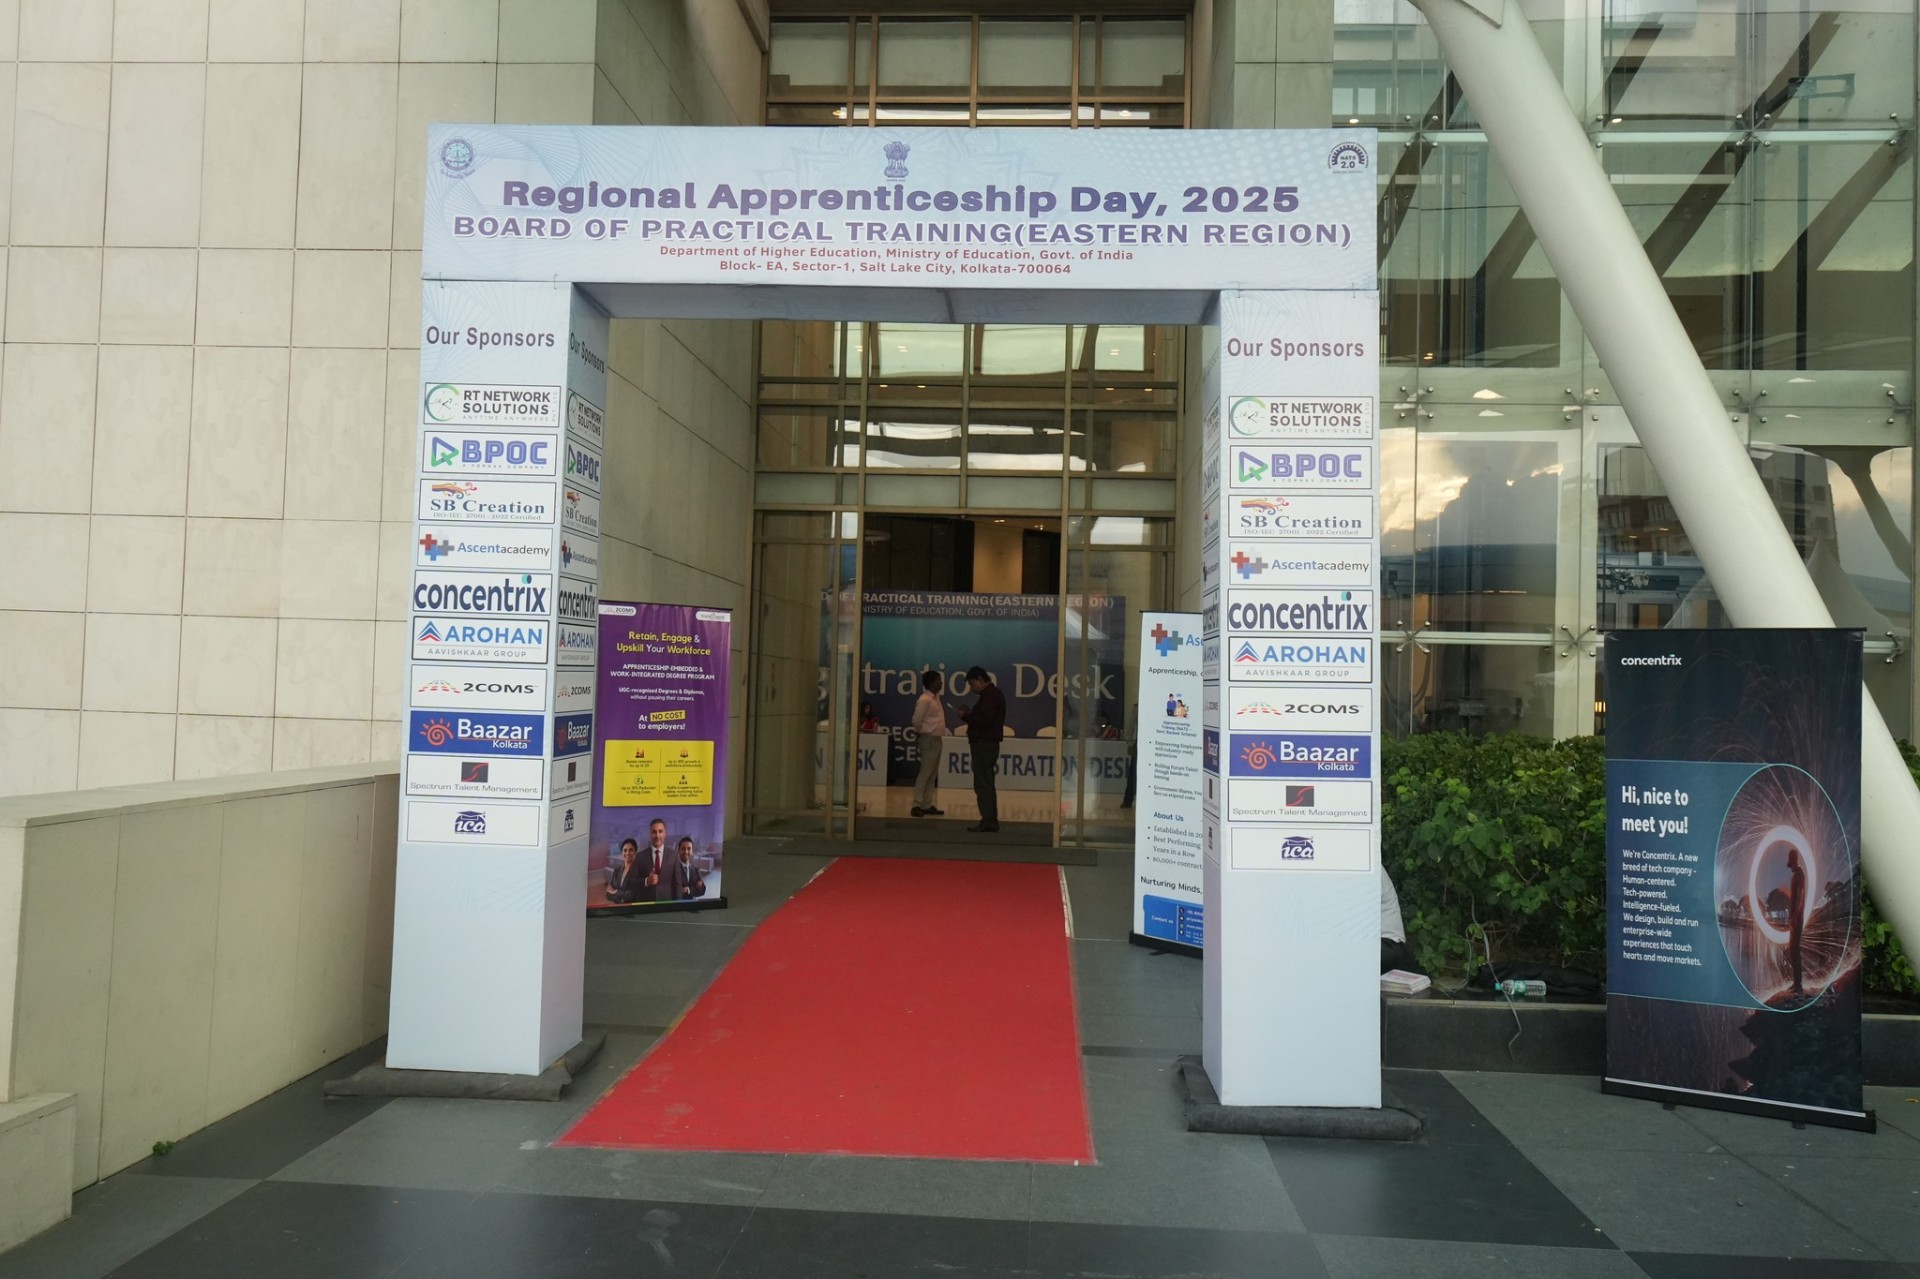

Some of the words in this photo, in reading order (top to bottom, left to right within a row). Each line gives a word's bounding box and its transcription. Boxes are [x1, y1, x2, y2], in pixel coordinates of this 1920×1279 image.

[1341, 161, 1356, 169] 2.0
[503, 181, 697, 214] Regional
[707, 183, 1057, 219] Apprenticeship
[1071, 186, 1168, 219] Day,
[1182, 186, 1299, 213] 2025
[454, 216, 572, 238] BOARD
[585, 218, 629, 239] OF
[641, 219, 833, 242] PRACTICAL
[845, 221, 1188, 247] TRAINING(EASTERN
[1203, 223, 1352, 248] REGION)
[660, 246, 739, 258] Department
[743, 247, 758, 257] of
[760, 247, 806, 260] Higher
[810, 248, 881, 260] Education,
[886, 248, 941, 261] Ministry
[945, 249, 960, 259] of
[963, 249, 1035, 261] Education,
[1040, 250, 1074, 260] Govt.
[1080, 250, 1095, 260] of
[1097, 250, 1134, 260] India
[720, 260, 762, 271] Block-
[767, 260, 788, 273] EA,
[793, 261, 855, 274] Sector-1,
[861, 261, 887, 272] Salt
[891, 262, 921, 273] Lake
[926, 263, 956, 275] City,
[961, 263, 1072, 274] Kolkata-700064
[426, 325, 461, 345] Our
[467, 326, 556, 351] Sponsors
[570, 332, 581, 355] Our
[581, 340, 605, 374] Sponsors
[1227, 337, 1263, 358] Our
[1270, 337, 1365, 361] Sponsors
[463, 390, 481, 402] RT
[483, 391, 552, 404] NETWORK
[462, 402, 549, 416] SOLUTIONS
[1270, 402, 1289, 414] RT
[1291, 402, 1364, 415] NETWORK
[462, 414, 500, 422] ANYTIME
[503, 416, 549, 424] ANYWHERE
[1269, 415, 1362, 428] SOLUTIONS
[461, 438, 549, 465] BPOC
[576, 450, 600, 483] BPOC
[1271, 453, 1363, 479] BPOC
[430, 498, 456, 512] SB
[462, 499, 545, 514] Creation
[574, 509, 598, 528] Creation
[1240, 514, 1268, 529] SB
[1274, 514, 1363, 529] Creation
[457, 541, 551, 557] Ascentacademy
[1271, 559, 1370, 573] Ascentacademy
[414, 574, 547, 613] concentrix
[853, 592, 925, 605] RACTICAL
[926, 594, 1055, 608] TRAINING(EASTERN
[559, 583, 596, 619] concentrix
[615, 607, 635, 615] 2COMS
[896, 605, 908, 614] OF
[910, 606, 965, 617] EDUCATION,
[968, 607, 993, 617] GOVT.
[995, 608, 1008, 617] OF
[1011, 608, 1040, 618] INDIA)
[1228, 591, 1368, 630] concentrix
[445, 625, 543, 645] AROHAN
[566, 631, 594, 649] AROHAN
[629, 631, 660, 643] Retain,
[661, 632, 693, 644] Engage
[694, 634, 701, 643] &
[427, 648, 490, 657] AAVISHKAAR
[493, 650, 528, 659] GROUP
[616, 643, 645, 654] Upskill
[646, 644, 665, 653] Your
[666, 645, 711, 657] Workforce
[1262, 644, 1366, 663] AROHAN
[1620, 653, 1683, 666] concentrix
[610, 670, 666, 679] WORK-INTEGRATED
[666, 672, 687, 680] DEGREE
[687, 673, 715, 681] PROGRAM
[1148, 666, 1200, 679] Apprenticeship,
[1245, 669, 1311, 677] AAVISHKAAR
[1315, 670, 1350, 678] GROUP
[463, 682, 535, 694] 2COMS
[570, 685, 592, 696] 2COMS
[658, 688, 678, 697] Degrees
[648, 695, 666, 703] pausing
[1284, 703, 1360, 714] 2COMS
[638, 714, 648, 722] At
[652, 713, 664, 721] NO
[664, 711, 684, 720] COST
[457, 717, 533, 741] Baazar
[567, 721, 590, 740] Baazar
[638, 722, 647, 730] to
[647, 722, 686, 733] employers!
[492, 740, 529, 750] Kolkata
[1280, 740, 1360, 762] Baazar
[948, 752, 1079, 778] RESTRATION
[1316, 761, 1355, 771] Kolkata
[409, 781, 452, 792] Spectrum
[455, 783, 480, 792] Talent
[482, 785, 539, 795] Management
[1621, 785, 1641, 806] Hi,
[1643, 786, 1672, 805] nice
[1674, 788, 1689, 806] to
[1153, 811, 1174, 822] About
[1175, 814, 1185, 823] Us
[1232, 807, 1276, 817] Spectrum
[1278, 808, 1307, 817] Talent
[1308, 810, 1368, 819] Management
[1153, 825, 1187, 837] Established
[1188, 830, 1195, 838] in
[1621, 816, 1656, 833] meet
[1658, 815, 1689, 838] you!
[1153, 835, 1167, 845] Best
[1167, 838, 1202, 850] Performing
[1152, 846, 1170, 855] Years
[1170, 848, 1177, 856] in
[1182, 850, 1196, 859] Row
[1622, 848, 1641, 859] We're
[1641, 850, 1678, 862] Concentrix.
[1678, 852, 1684, 861] A
[1685, 854, 1699, 863] new
[1622, 861, 1641, 871] breed
[1641, 863, 1649, 872] of
[1648, 863, 1663, 873] tech
[1663, 865, 1692, 877] company
[1140, 876, 1177, 891] Nurturing
[1178, 882, 1203, 895] Minds,
[1622, 874, 1677, 887] Human-centered.
[1622, 886, 1668, 899] Tech-powered.
[1622, 899, 1682, 913] Intelligence-fueled.
[1622, 912, 1634, 922] We
[1657, 915, 1674, 925] build
[1674, 917, 1687, 926] and
[1687, 919, 1700, 928] run
[1622, 926, 1673, 938] enterprise-wide
[1622, 938, 1660, 950] experiences
[1660, 940, 1674, 950] that
[1674, 941, 1693, 952] touch
[1622, 949, 1643, 960] hearts
[1643, 952, 1657, 962] and
[1656, 954, 1675, 963] move
[1674, 955, 1703, 967] markets.
